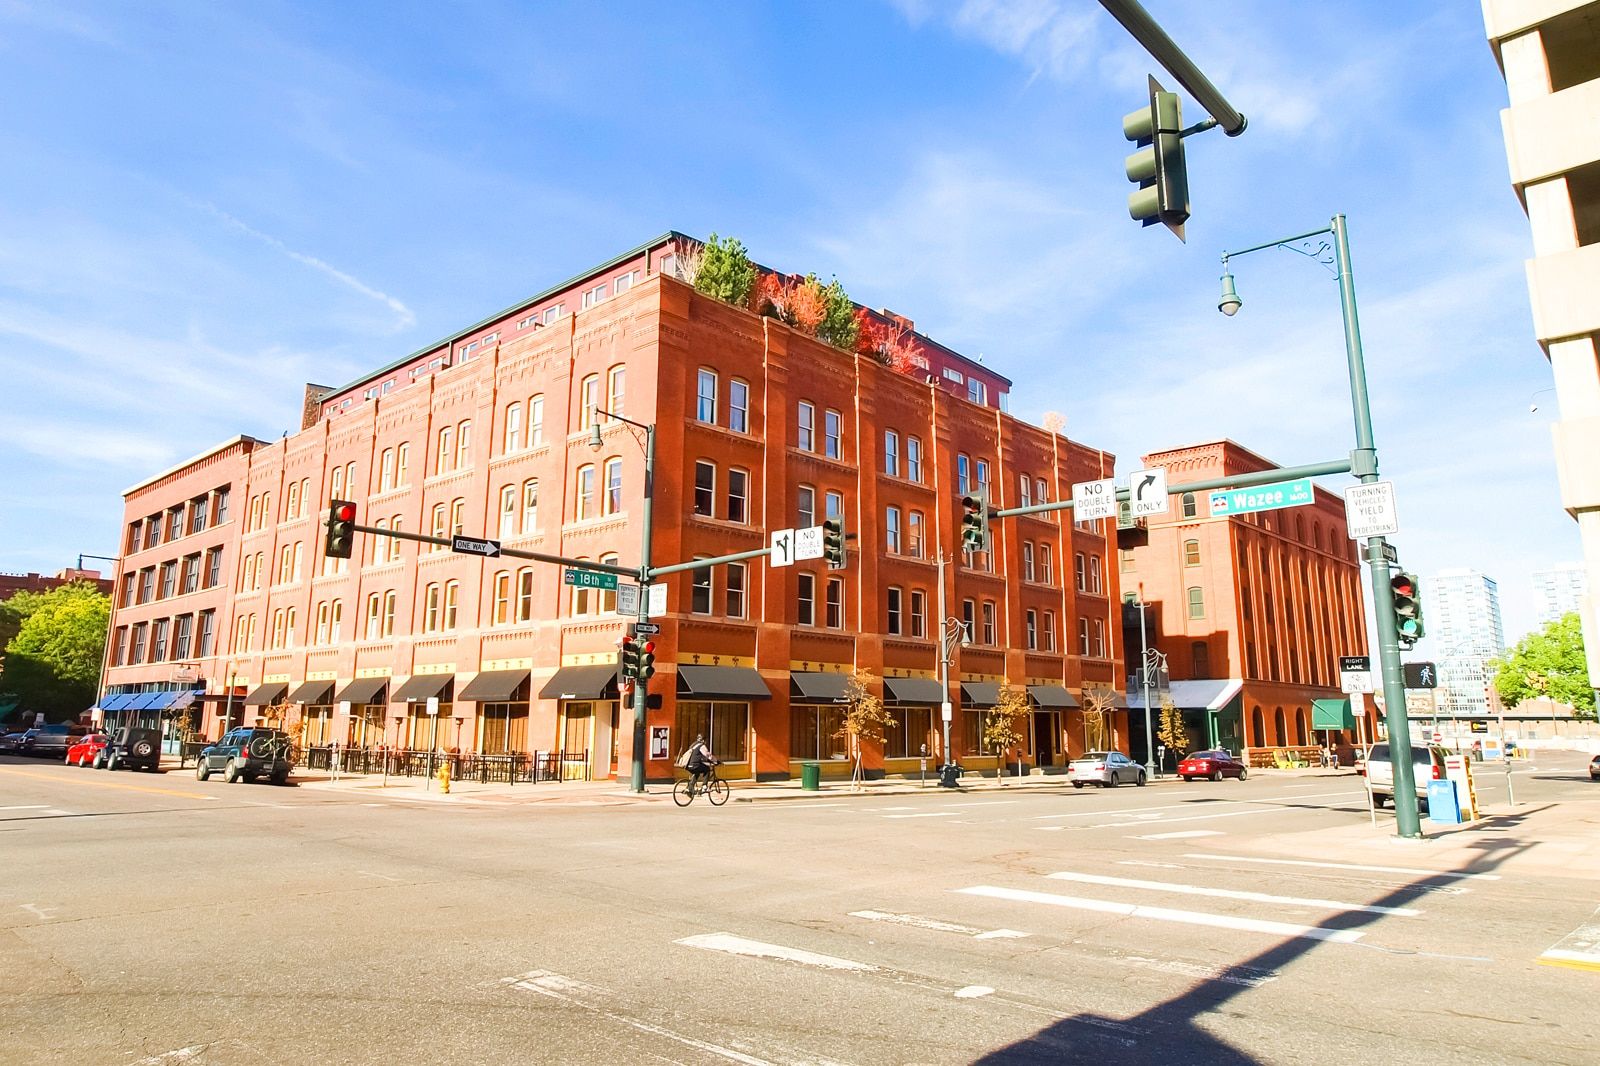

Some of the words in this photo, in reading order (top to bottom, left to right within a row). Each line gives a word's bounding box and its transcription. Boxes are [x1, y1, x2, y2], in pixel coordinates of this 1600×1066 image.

[1084, 483, 1103, 495] NO
[1352, 486, 1387, 498] TURNING
[1078, 495, 1111, 508] DOUBLE
[1232, 490, 1283, 509] Wazee
[1354, 496, 1387, 506] VEHICLES
[1084, 506, 1108, 516] TURN
[1136, 500, 1162, 513] ONLY
[1359, 505, 1384, 516] YIELD
[802, 530, 816, 540] NO
[1354, 523, 1395, 535] PEDESTRIANS
[457, 540, 471, 550] ONE
[473, 543, 487, 551] WAY
[798, 539, 821, 551] DOUBLE
[801, 549, 818, 557] TURN
[580, 573, 600, 587] 18th
[1347, 683, 1367, 691] ONLY
